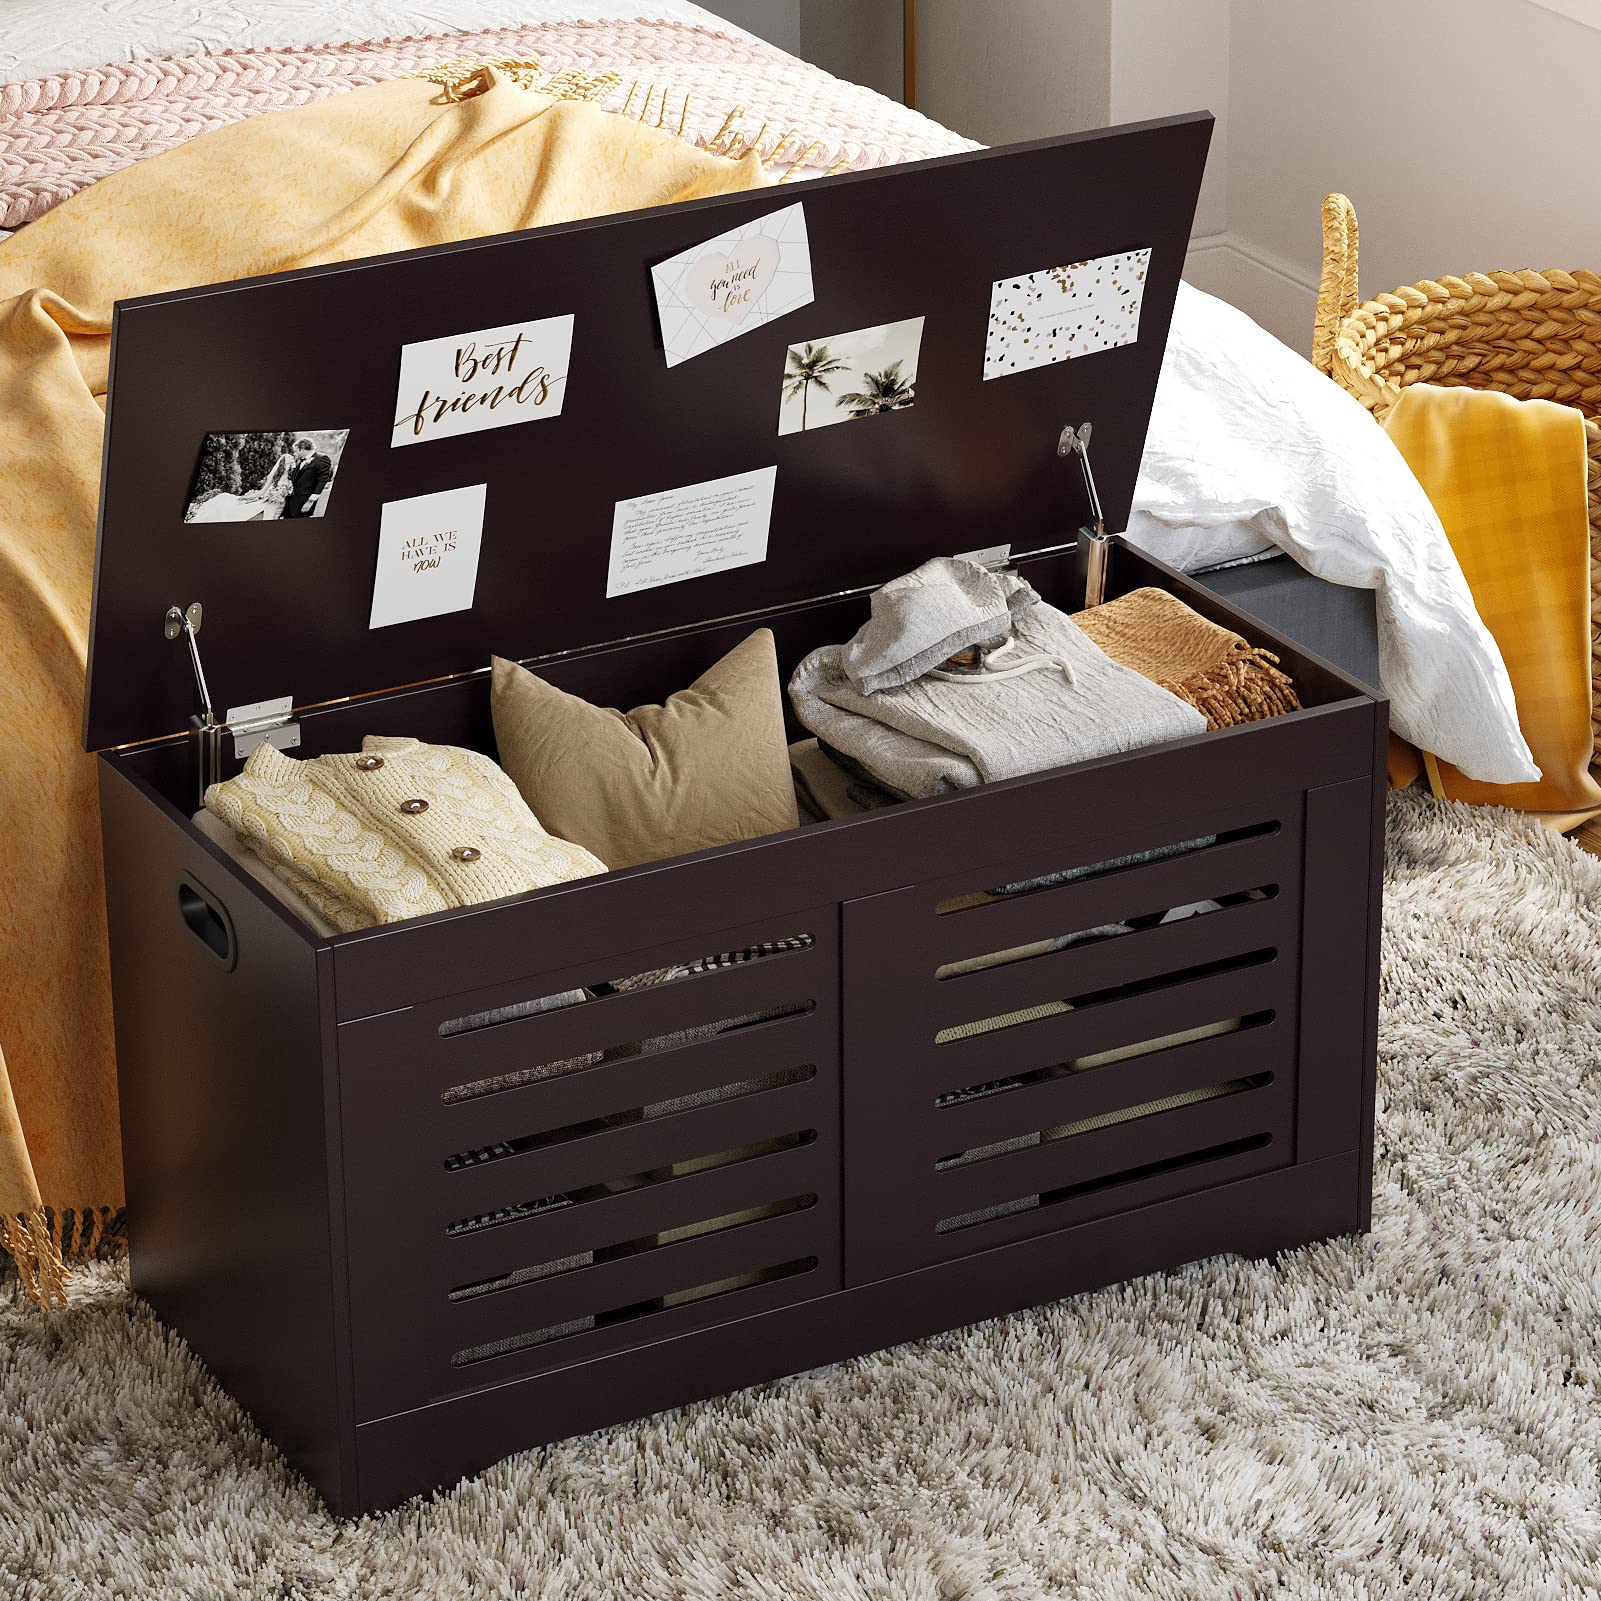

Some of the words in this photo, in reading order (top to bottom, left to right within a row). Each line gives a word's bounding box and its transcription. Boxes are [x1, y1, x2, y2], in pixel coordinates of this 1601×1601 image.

[725, 259, 743, 274] ALL
[710, 278, 730, 301] you
[731, 257, 761, 283] need
[718, 288, 751, 312] love
[454, 332, 533, 383] Best
[394, 366, 567, 436] friends
[402, 536, 428, 549] ALL
[433, 530, 457, 542] WE
[401, 545, 437, 560] HAVE
[443, 541, 457, 552] IS
[413, 555, 441, 573] now
